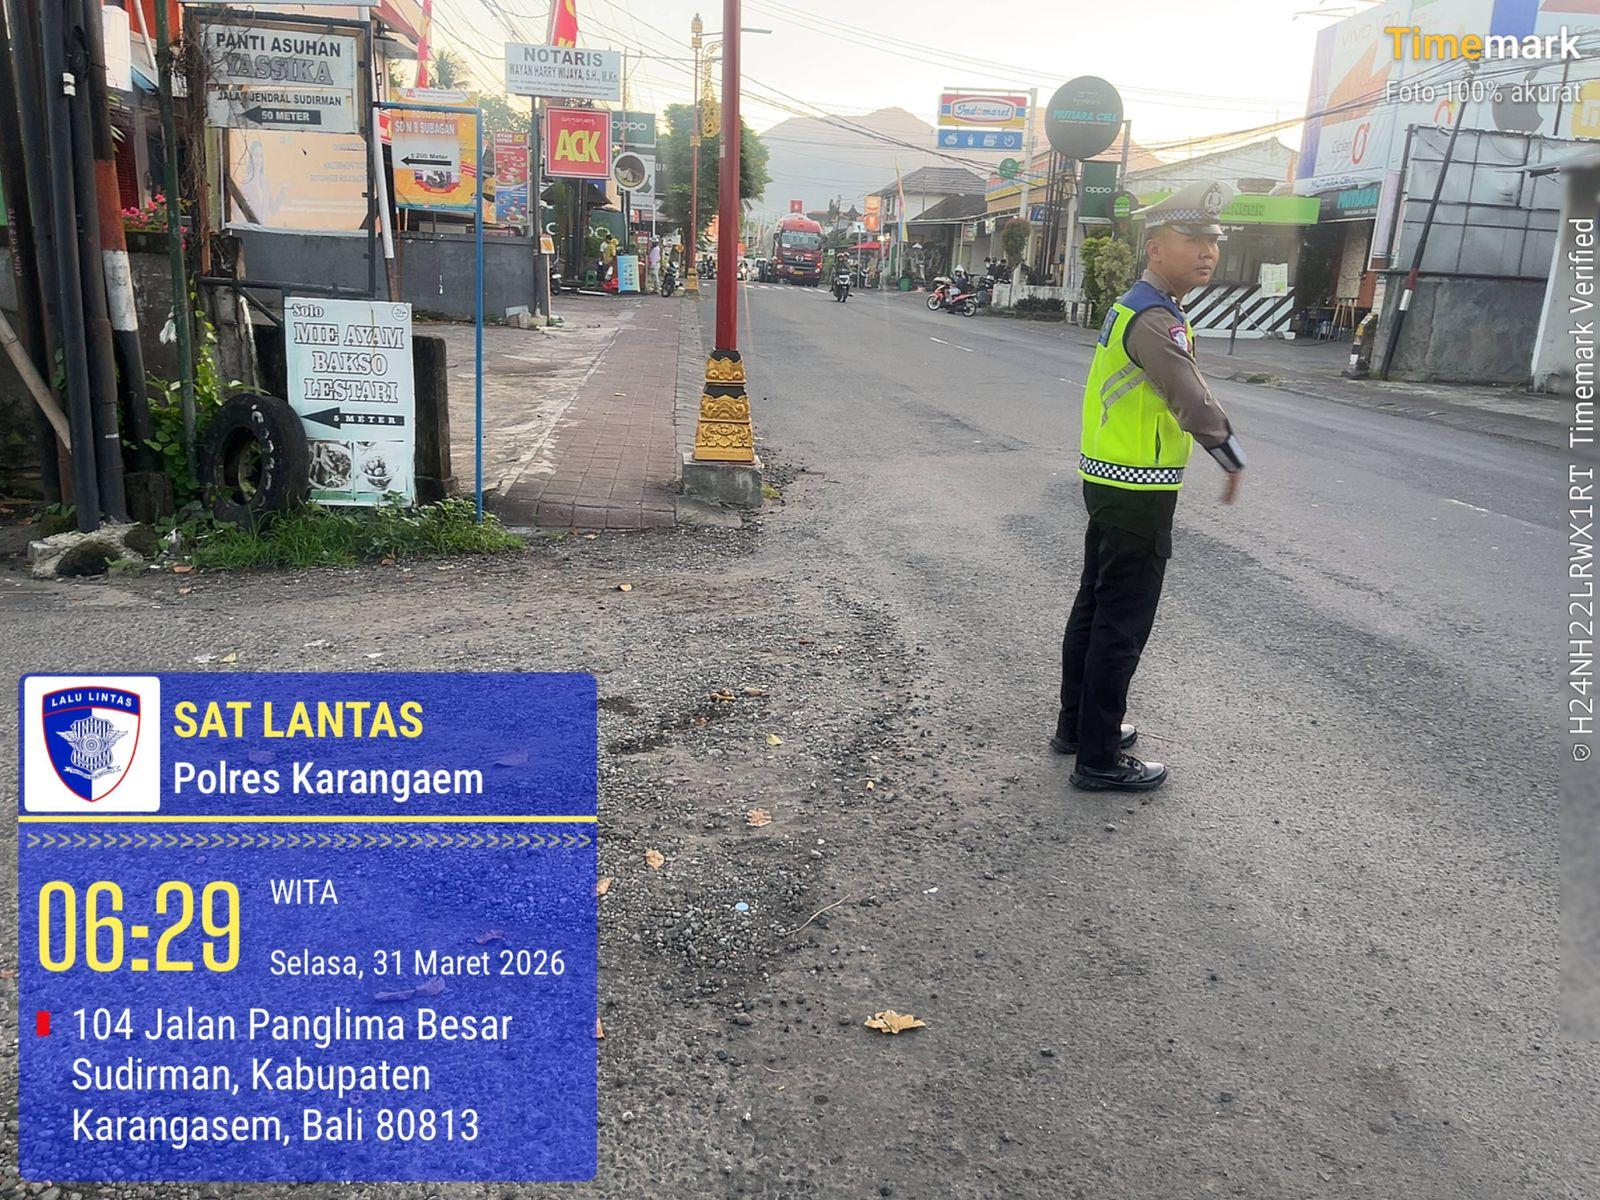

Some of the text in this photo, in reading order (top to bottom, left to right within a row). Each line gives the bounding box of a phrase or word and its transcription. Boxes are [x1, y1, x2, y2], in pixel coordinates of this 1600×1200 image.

[216, 33, 342, 58] PANTI ASUHAN
[524, 47, 603, 67] NOTARIS
[223, 51, 334, 86] YASSIKA
[508, 64, 533, 76] WAYAN
[534, 65, 556, 78] HARRY
[250, 92, 291, 104] JENDRAL
[294, 92, 342, 106] SUDIRMAN
[261, 110, 310, 121] 50 METER
[955, 104, 1011, 117] Indomaret
[395, 120, 405, 132] SD
[406, 121, 413, 132] N
[420, 122, 455, 135] SUBAGAN
[554, 129, 602, 163] ACK
[292, 303, 325, 319] Solo
[293, 322, 404, 349] MIE AYAM
[312, 350, 388, 376] BAKSO
[304, 378, 399, 404] LESTARI
[345, 414, 397, 424] METER
